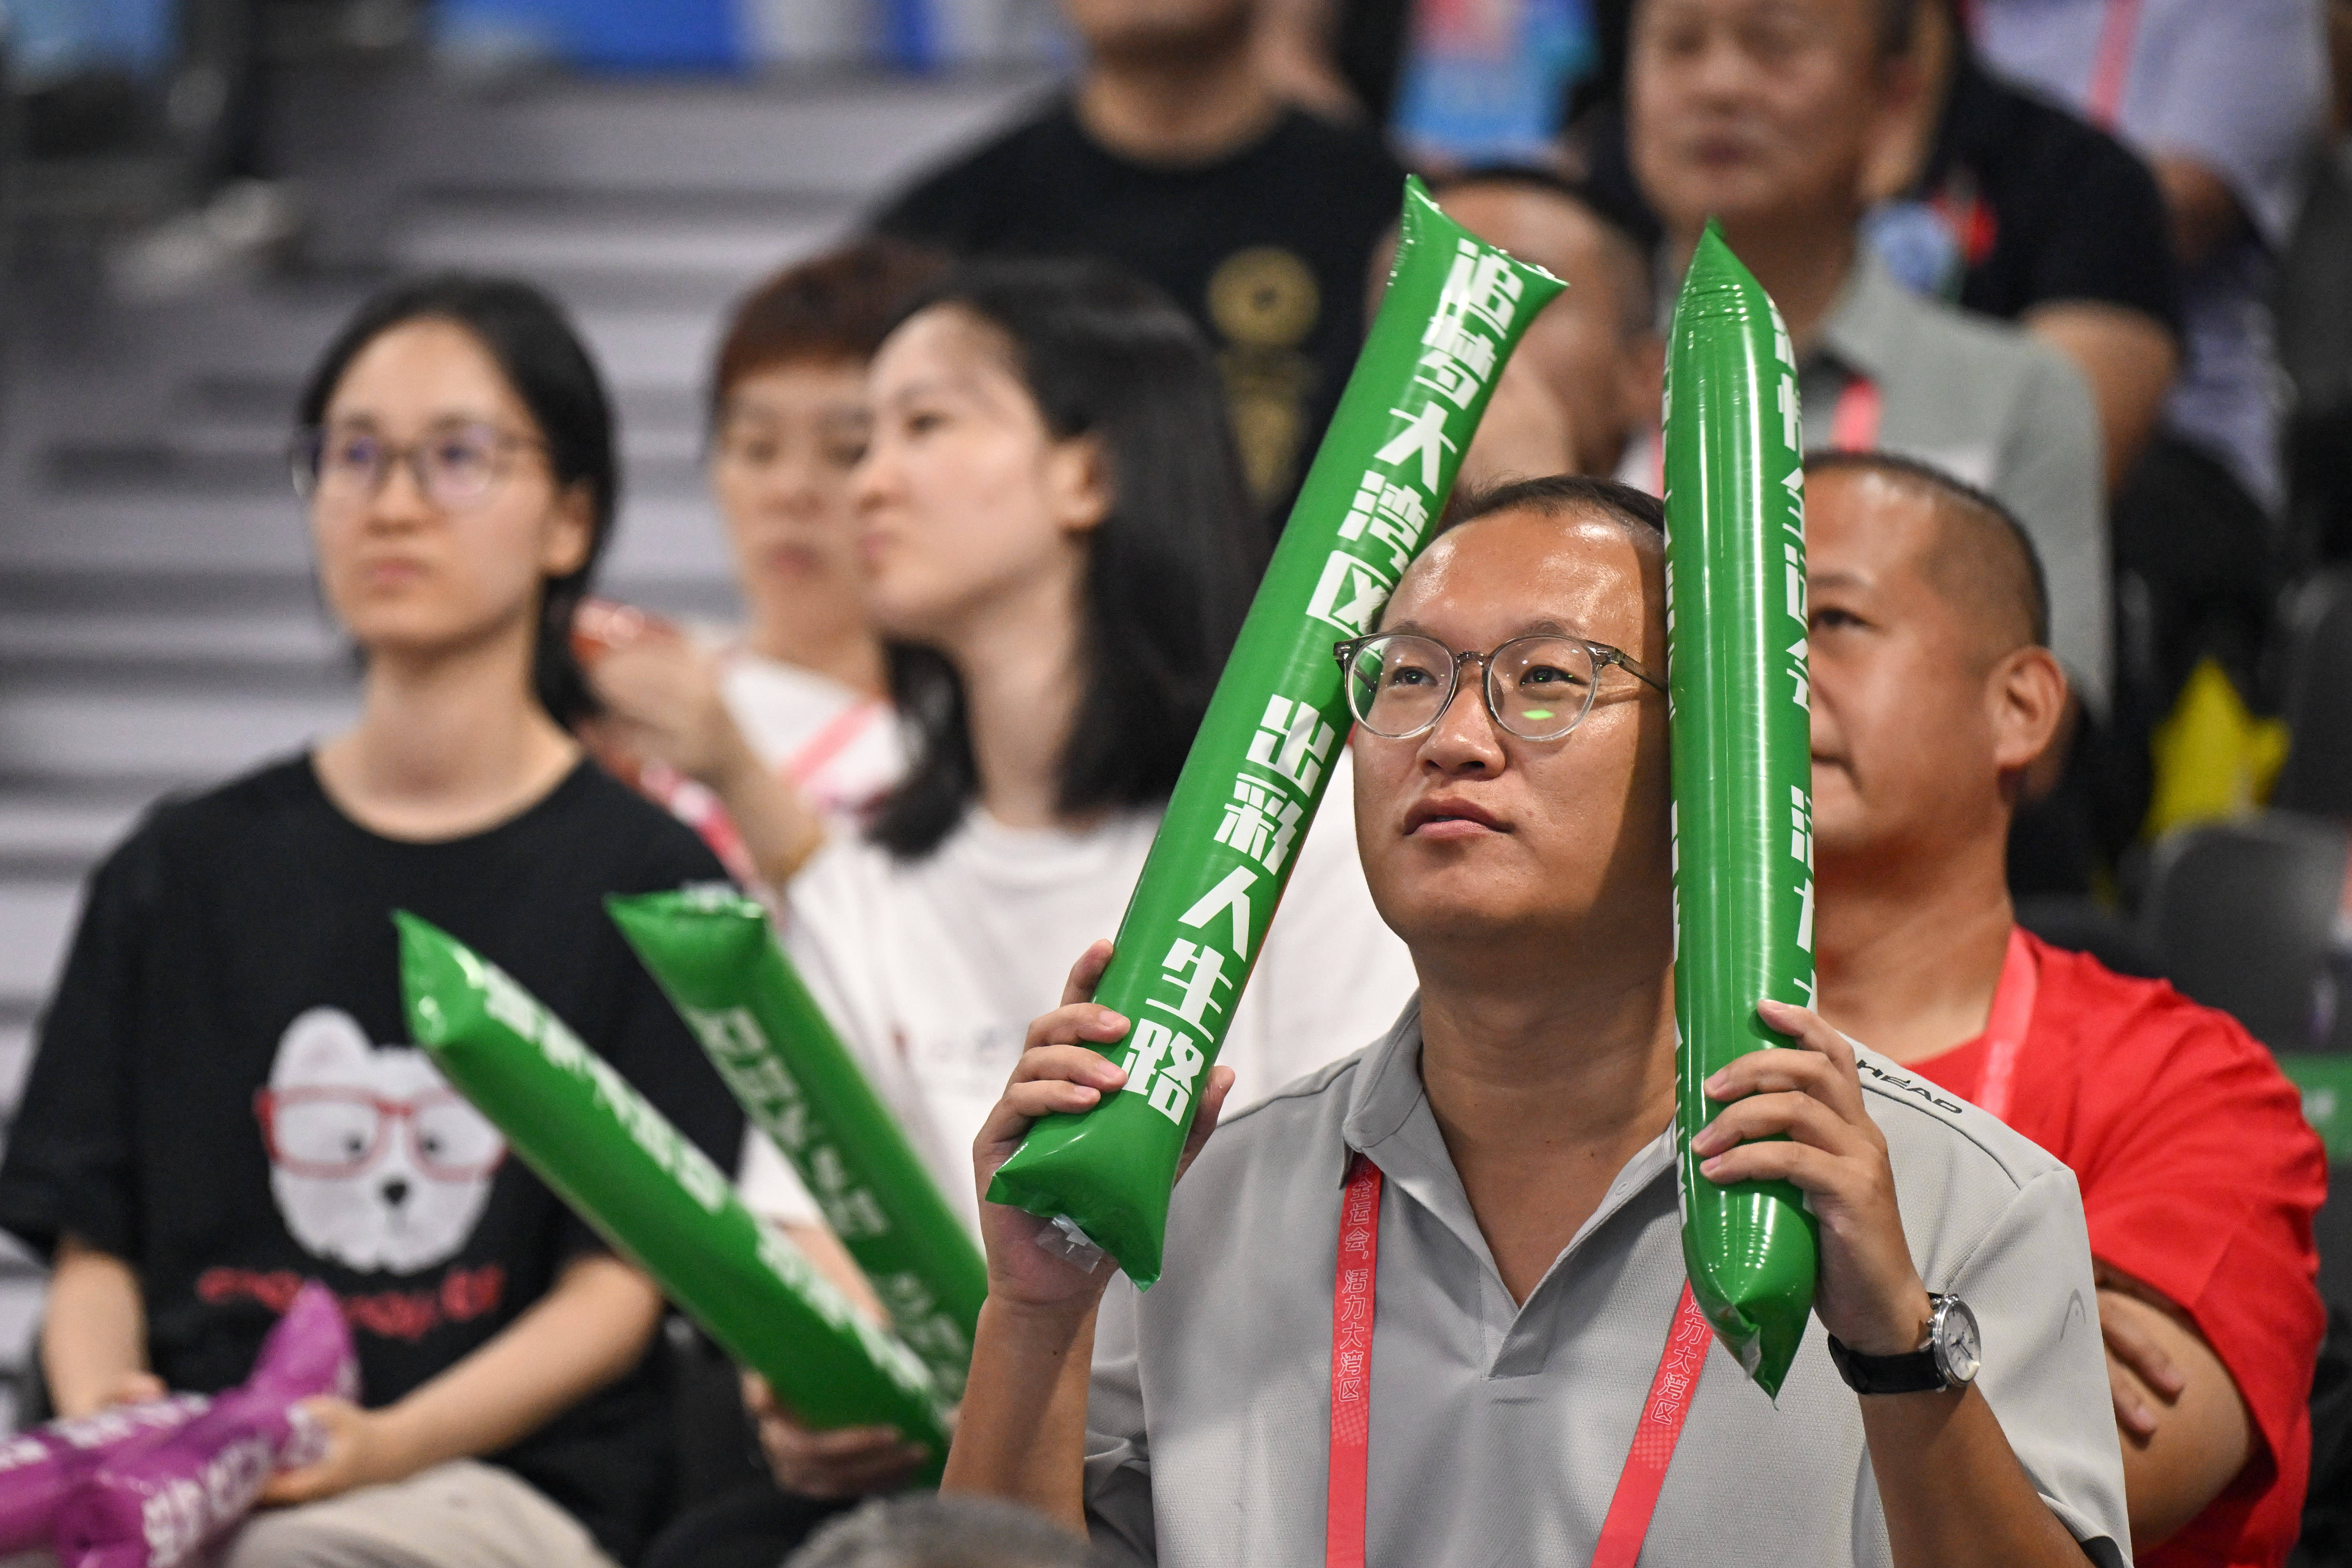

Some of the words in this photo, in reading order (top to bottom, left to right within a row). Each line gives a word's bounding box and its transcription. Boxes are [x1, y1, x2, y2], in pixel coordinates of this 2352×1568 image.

[1121, 693, 1336, 1126] 出彩人生路
[1857, 1059, 1962, 1114] HEAD
